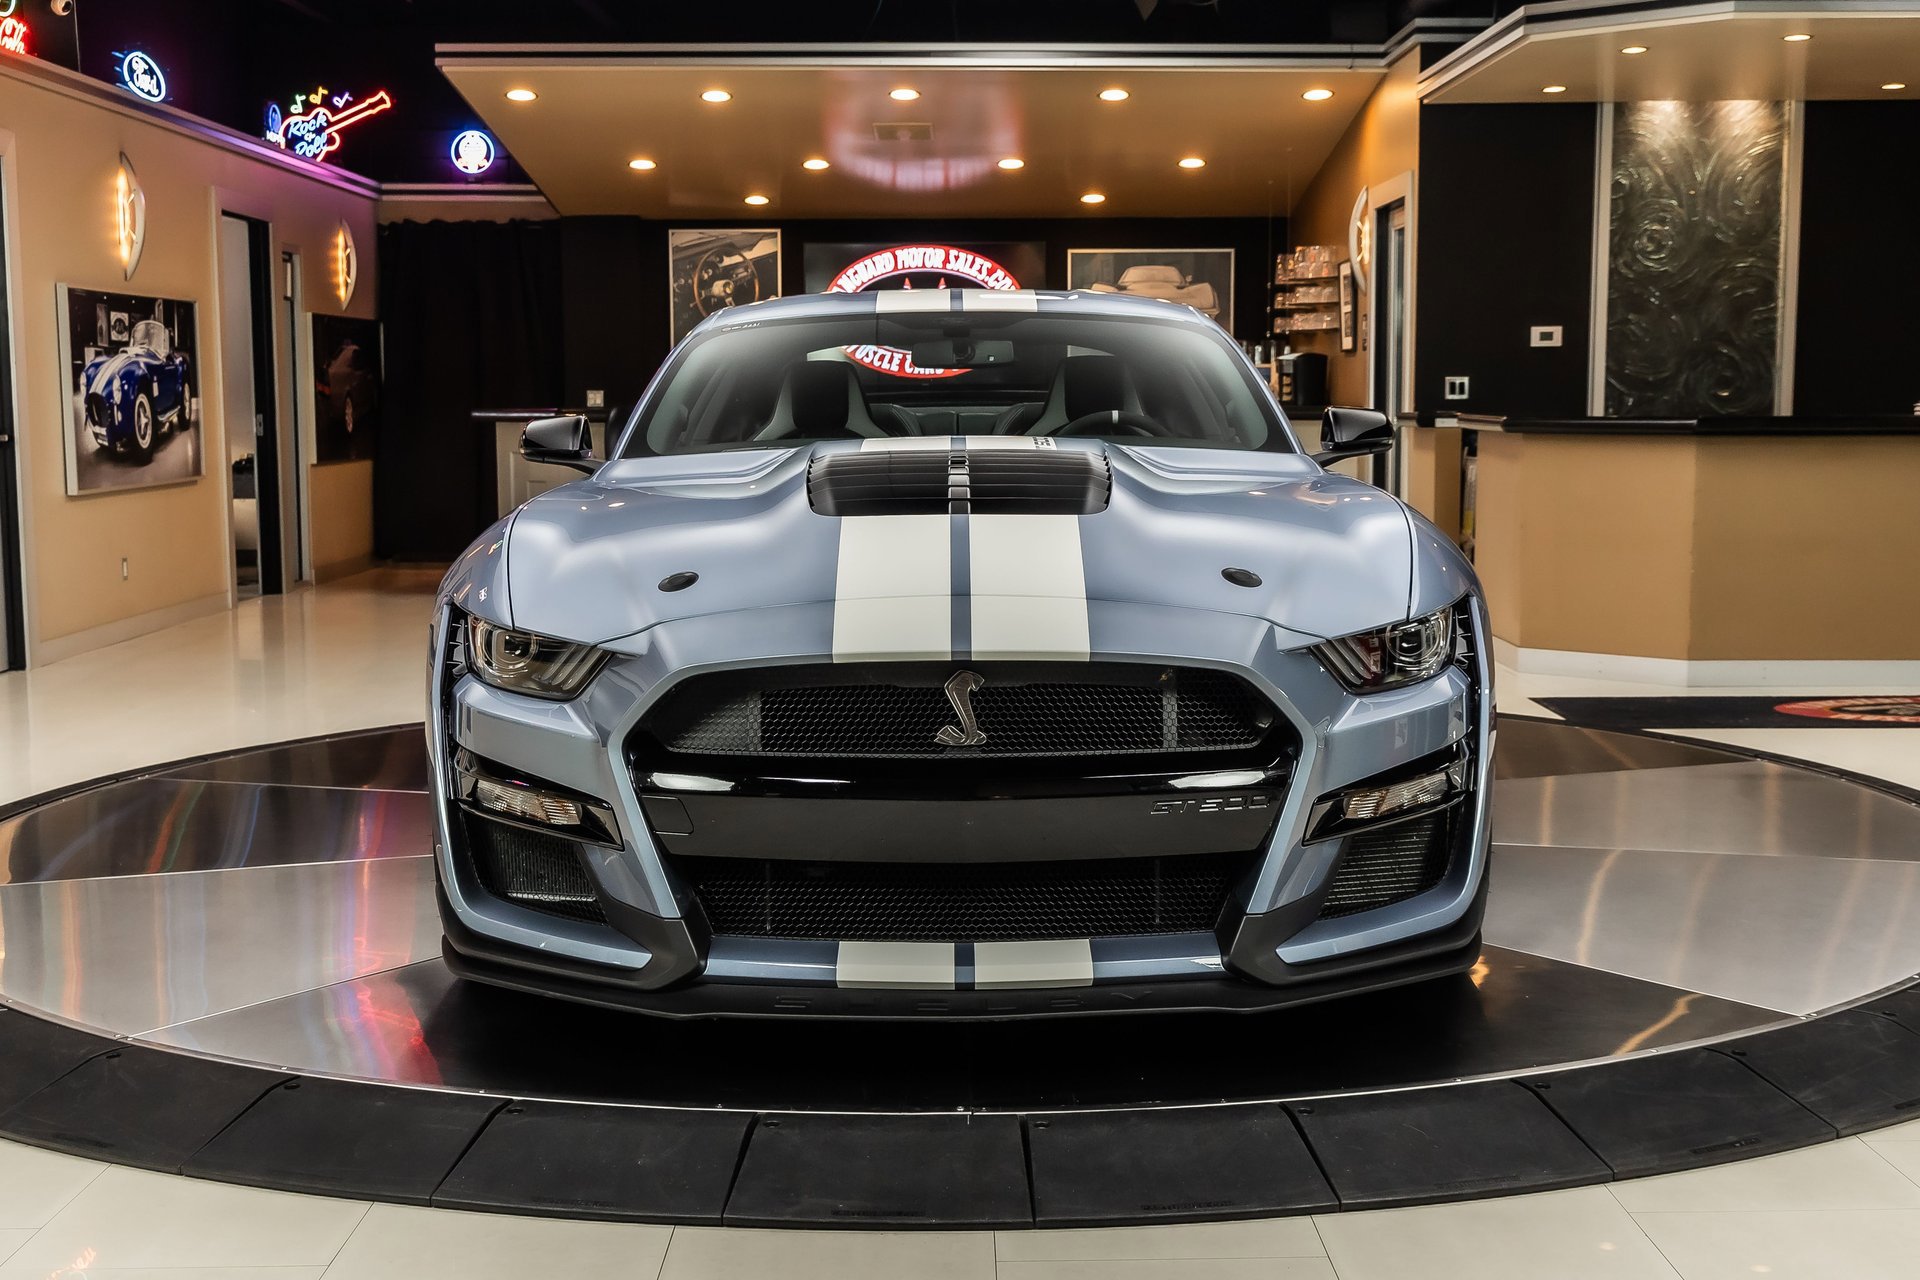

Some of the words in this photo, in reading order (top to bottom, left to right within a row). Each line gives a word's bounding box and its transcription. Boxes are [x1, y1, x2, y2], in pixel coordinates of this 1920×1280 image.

[131, 56, 159, 96] Ford
[288, 110, 328, 139] Rock
[831, 251, 895, 294] NGUARD
[894, 247, 946, 270] MOTOR
[945, 249, 1017, 291] SALES.CO
